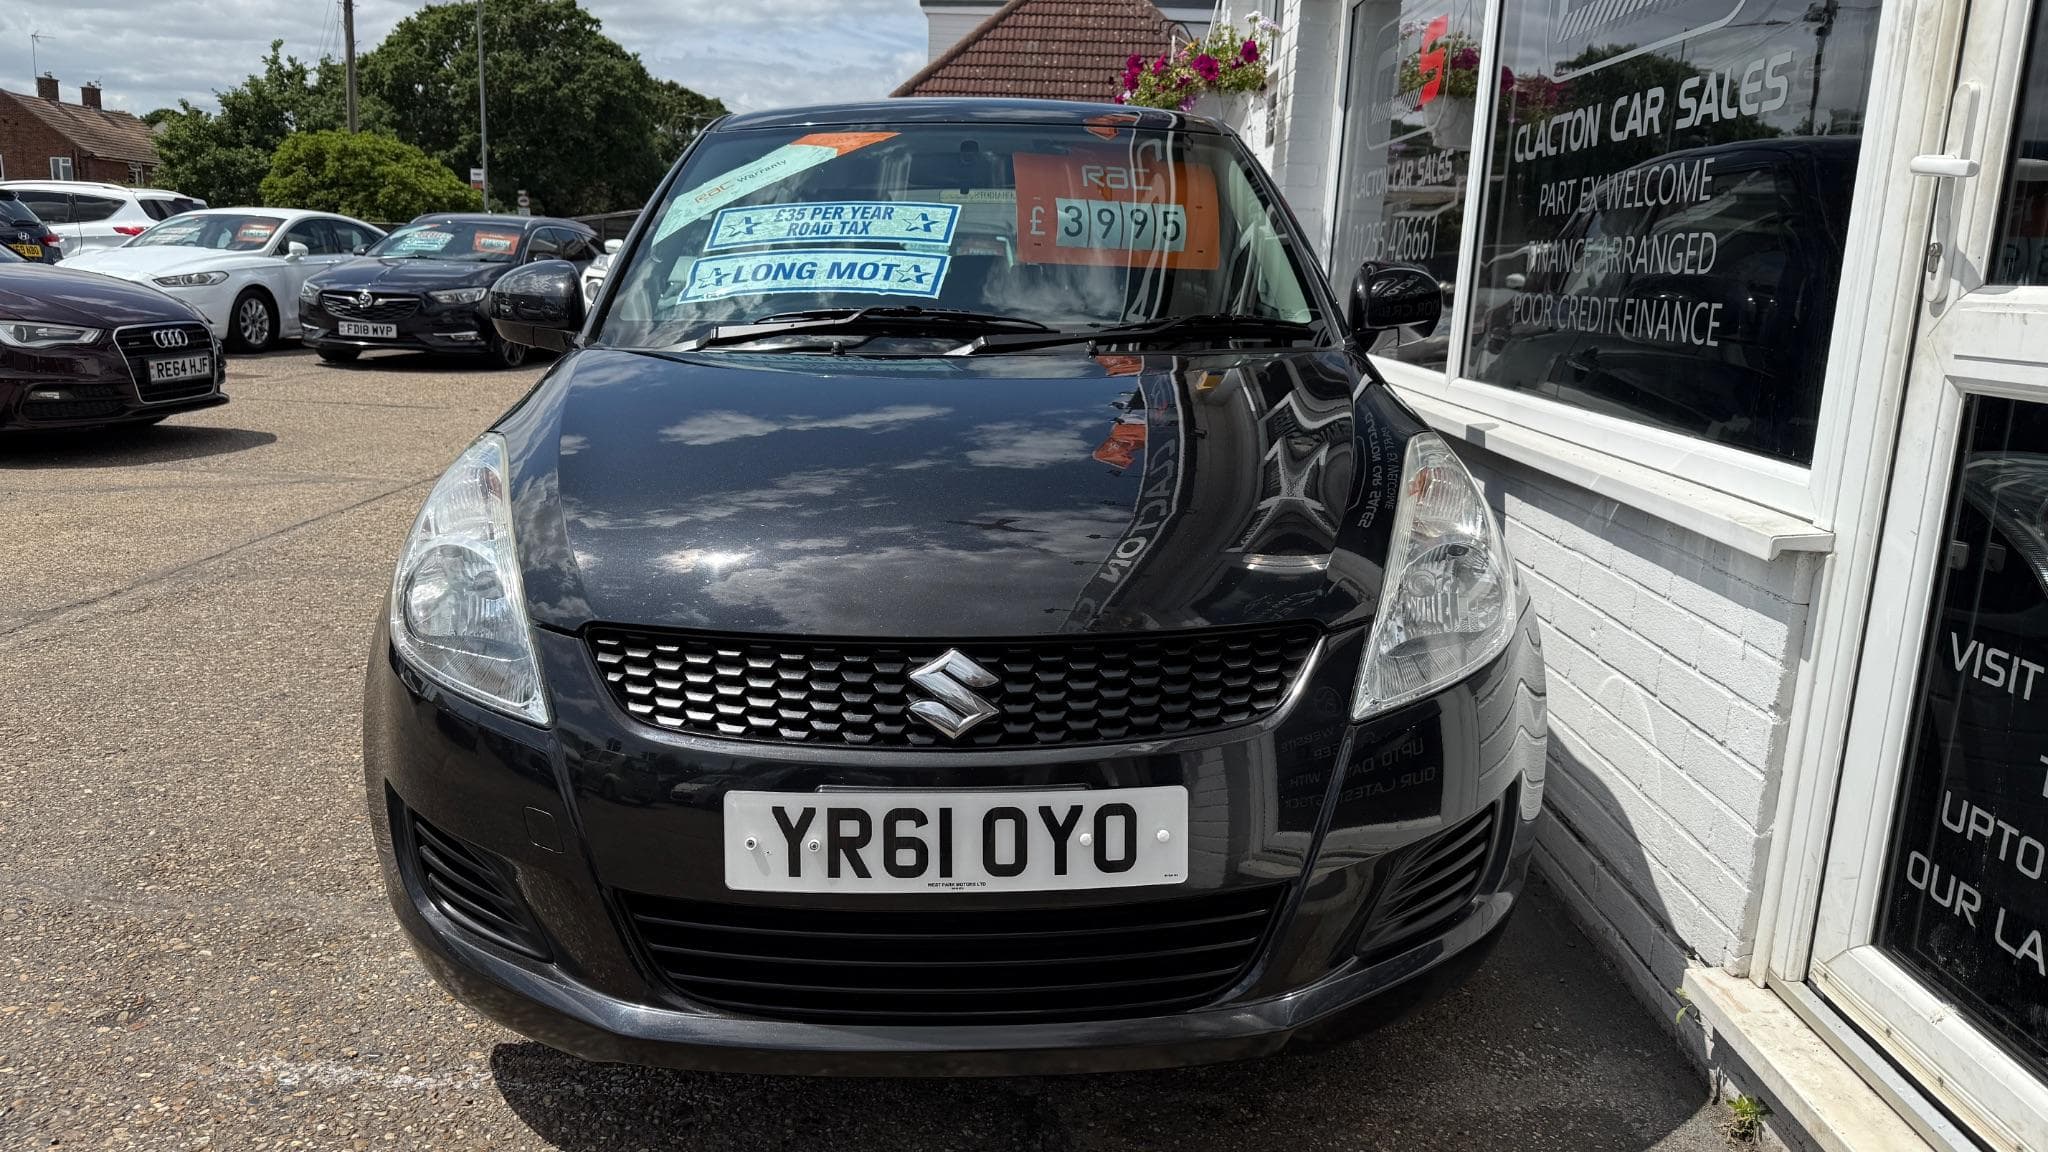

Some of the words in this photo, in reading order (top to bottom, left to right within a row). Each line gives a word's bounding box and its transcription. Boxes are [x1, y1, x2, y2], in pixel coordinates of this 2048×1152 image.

[1514, 104, 1601, 162] CLACTON
[1611, 86, 1664, 142] CAR
[1676, 50, 1793, 130] SALES
[1393, 160, 1413, 191] CAR
[1417, 148, 1454, 186] SALES
[1539, 178, 1577, 216] PART
[1579, 175, 1602, 213] EX
[1606, 157, 1715, 210] WELCOME
[774, 208, 807, 223] £35
[811, 206, 844, 220] PER
[851, 206, 894, 220] YEAR
[786, 222, 833, 236] ROAD
[840, 221, 872, 235] TAX
[1064, 205, 1180, 242] 3995
[1388, 213, 1438, 261] 426661
[732, 262, 817, 283] LONG
[827, 262, 901, 281] MOT
[1526, 238, 1594, 273] FINANCE
[1598, 232, 1717, 275] ARRANGED
[347, 323, 369, 335] FD18
[371, 324, 393, 336] WVP
[1512, 292, 1552, 327] POOR
[1557, 294, 1619, 335] CREDIT
[1623, 298, 1723, 347] FINANCE
[156, 360, 187, 379] RE64
[189, 357, 209, 374] HJF
[1951, 631, 2045, 701] VISIT
[772, 805, 952, 879] YR61
[982, 803, 1137, 877] OYO
[1941, 791, 2045, 880] UPTO
[1907, 851, 1982, 928] OUR
